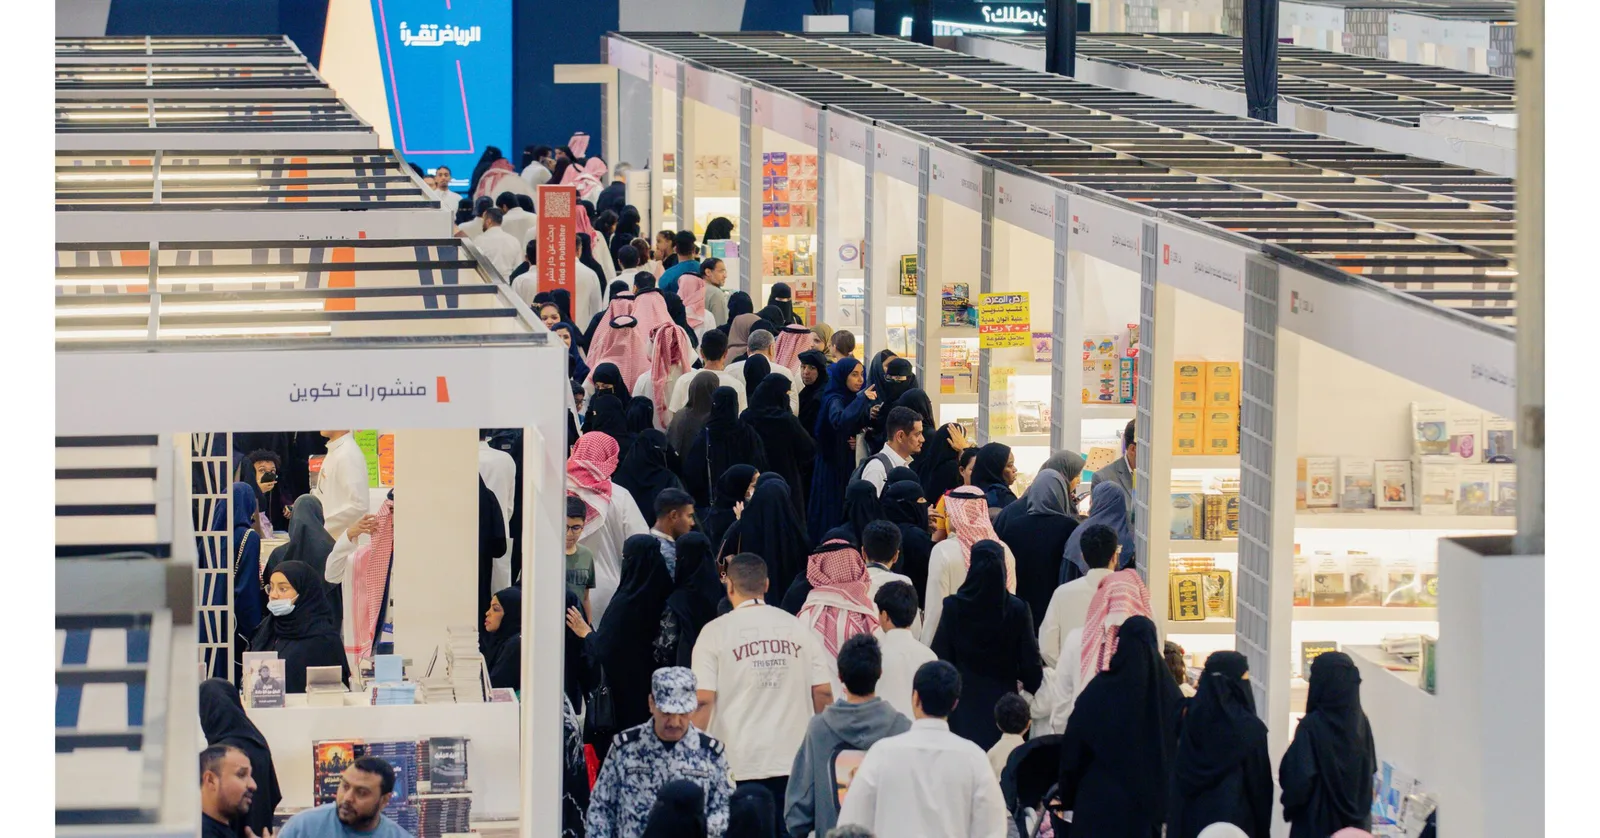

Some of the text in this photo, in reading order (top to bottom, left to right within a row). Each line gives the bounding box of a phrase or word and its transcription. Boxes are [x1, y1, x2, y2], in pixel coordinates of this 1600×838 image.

[982, 6, 1038, 26] بطلك؟
[400, 21, 481, 46] الرياض تقرأ
[545, 224, 556, 282] ابحث عن دار نشر
[980, 296, 1008, 305] المعرض
[289, 378, 426, 402] منشورات تكوين
[732, 640, 802, 662] VICTORY
